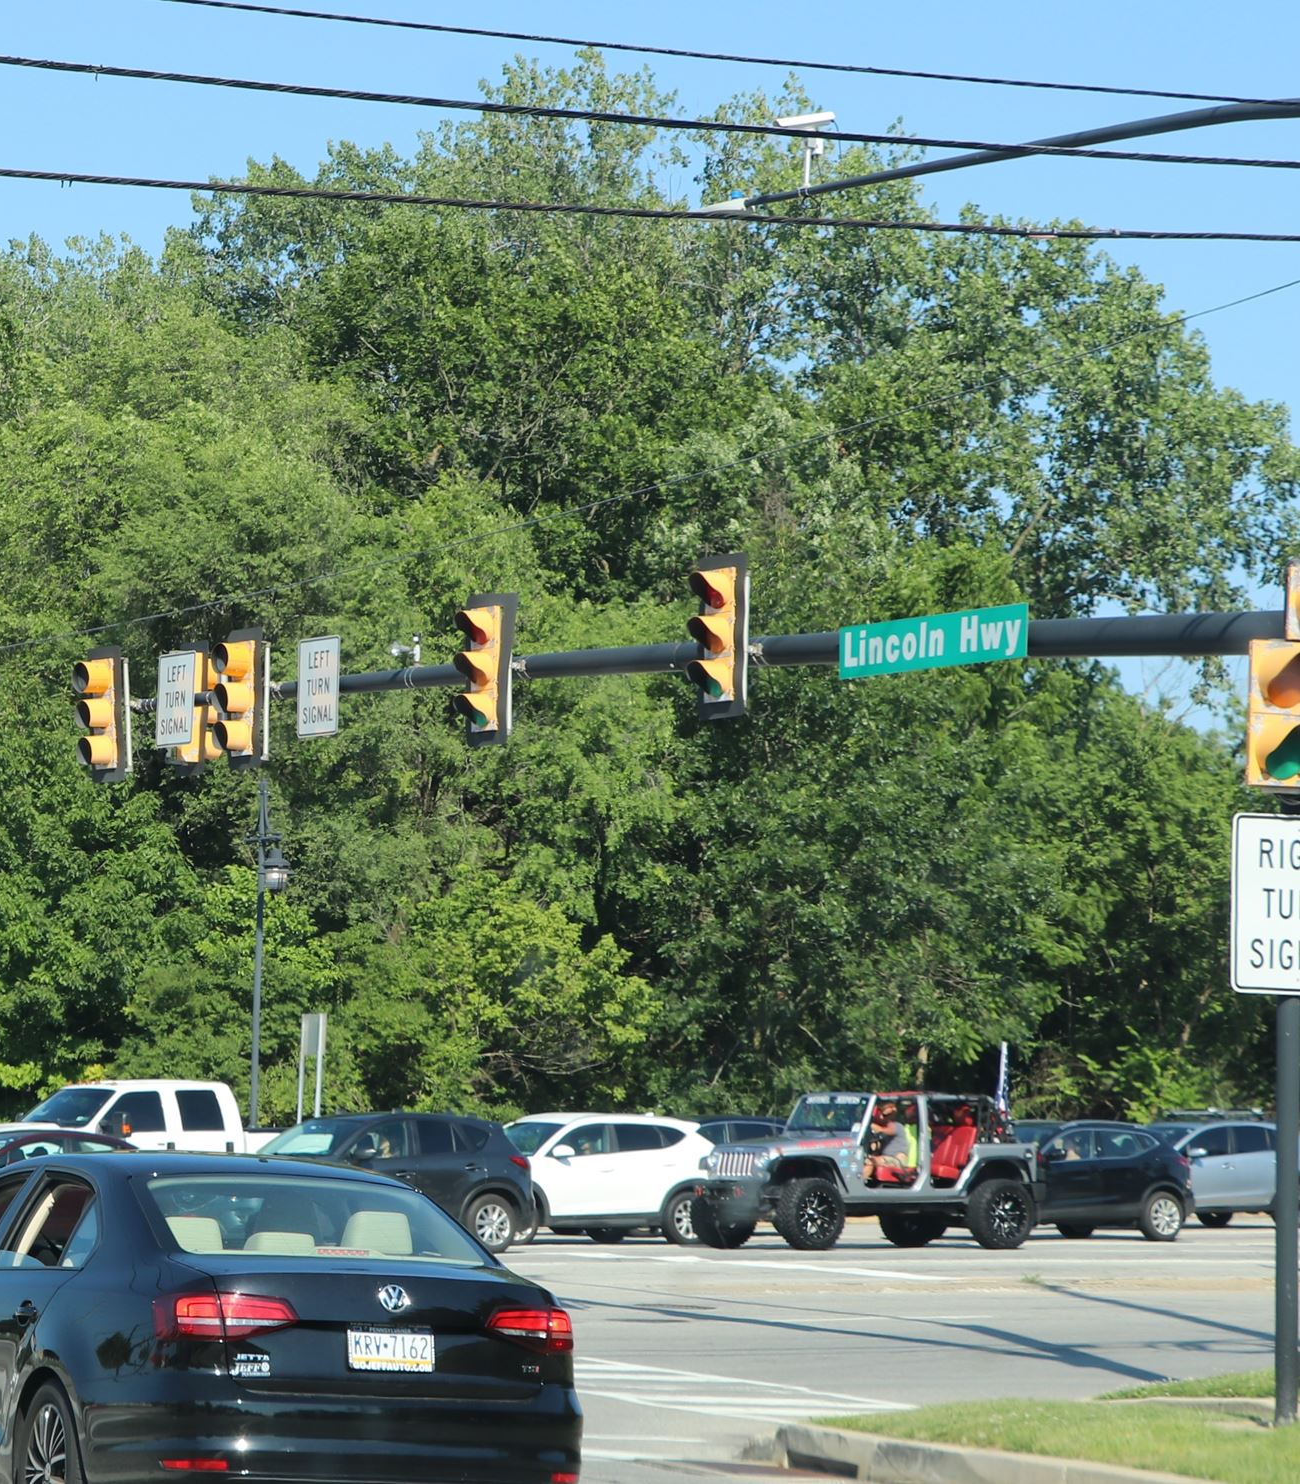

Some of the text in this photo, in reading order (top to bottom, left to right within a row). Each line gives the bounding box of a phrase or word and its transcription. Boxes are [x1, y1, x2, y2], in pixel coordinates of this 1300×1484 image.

[843, 615, 1021, 668] Lincoln Hwy
[308, 650, 330, 670] LEFT
[166, 664, 186, 683] LEFT
[307, 678, 330, 697] TURN
[165, 691, 186, 709] TURN
[302, 704, 333, 725] SIGNAL
[160, 716, 189, 735] SIGNAL
[1262, 888, 1300, 920] TU
[1250, 938, 1300, 970] SIG
[234, 1353, 270, 1361] JETTA
